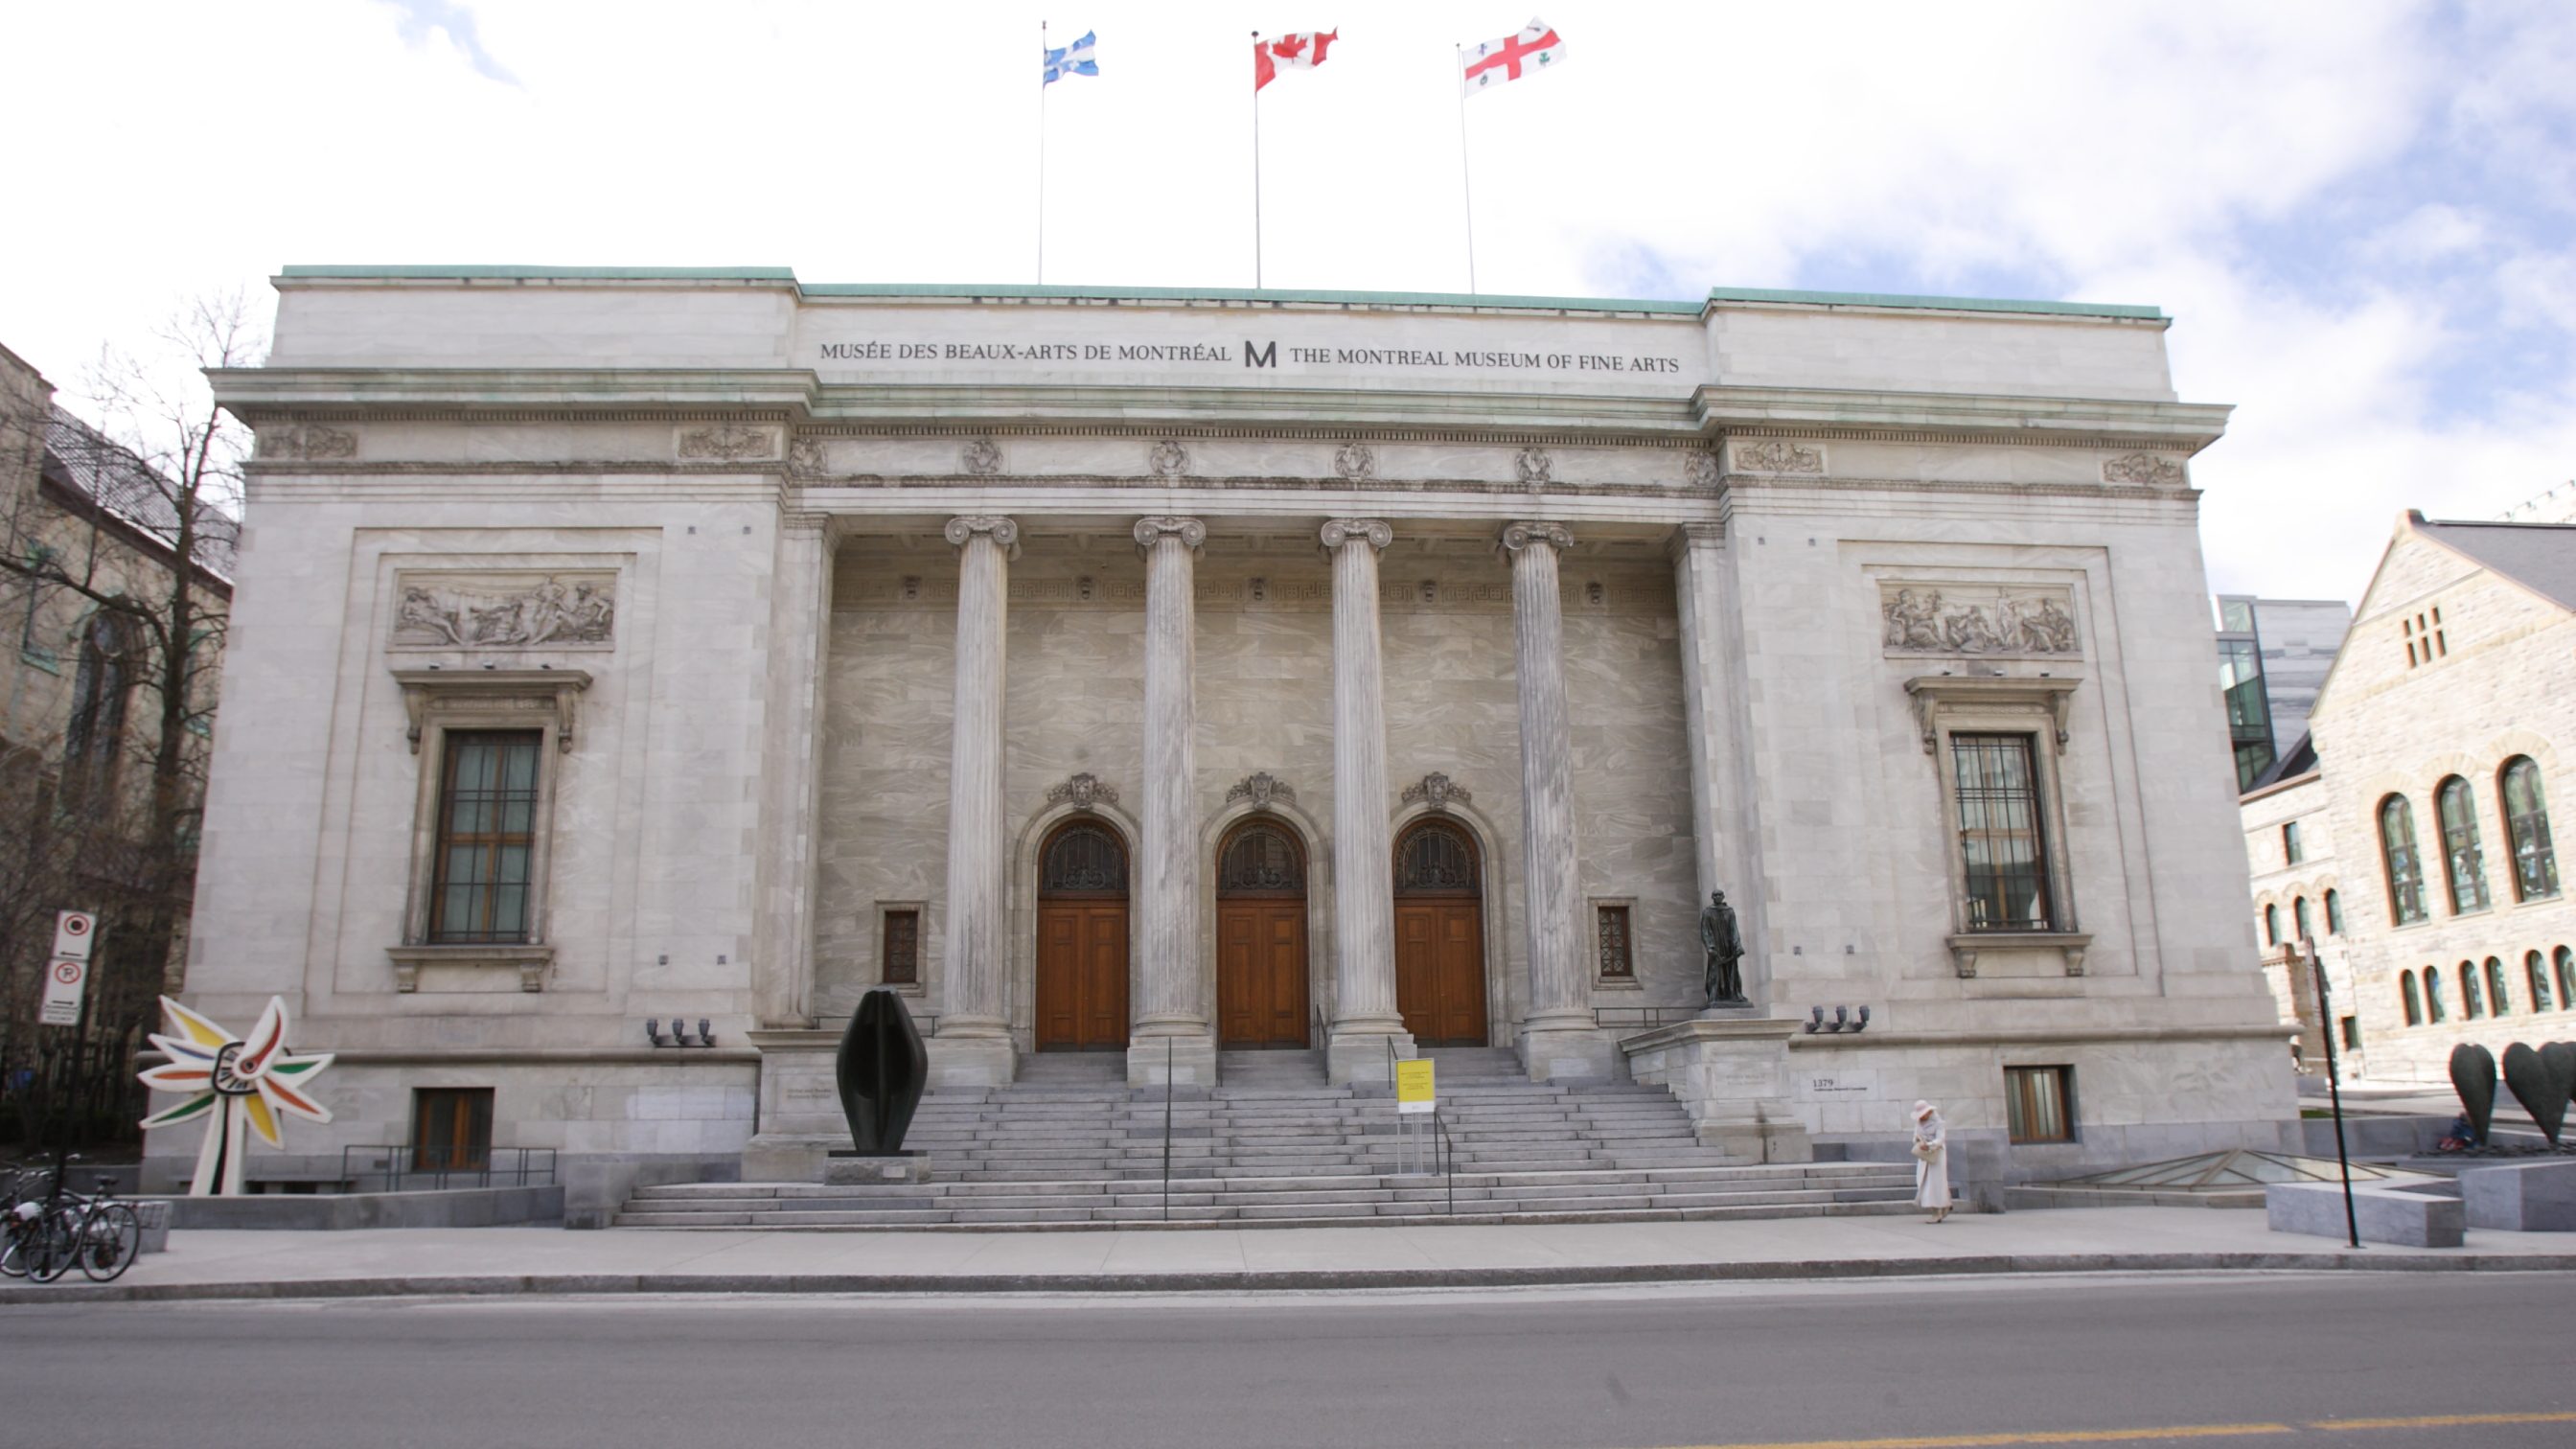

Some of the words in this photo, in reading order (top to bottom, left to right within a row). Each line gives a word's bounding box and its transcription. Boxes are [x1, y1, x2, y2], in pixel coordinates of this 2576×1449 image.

[819, 340, 892, 360] MUSÉE
[898, 343, 938, 360] DES
[944, 343, 1078, 361] BEAUX-ARTS
[1083, 344, 1112, 360] DE
[1117, 341, 1232, 362] MONTRÉAL
[1244, 339, 1277, 369] M
[1288, 347, 1332, 364] THE
[1337, 348, 1450, 367] MONTREAL
[1454, 351, 1542, 369] MUSEUM
[1546, 353, 1573, 370] OF
[1577, 355, 1624, 372] FINE
[1629, 356, 1680, 374] ARTS
